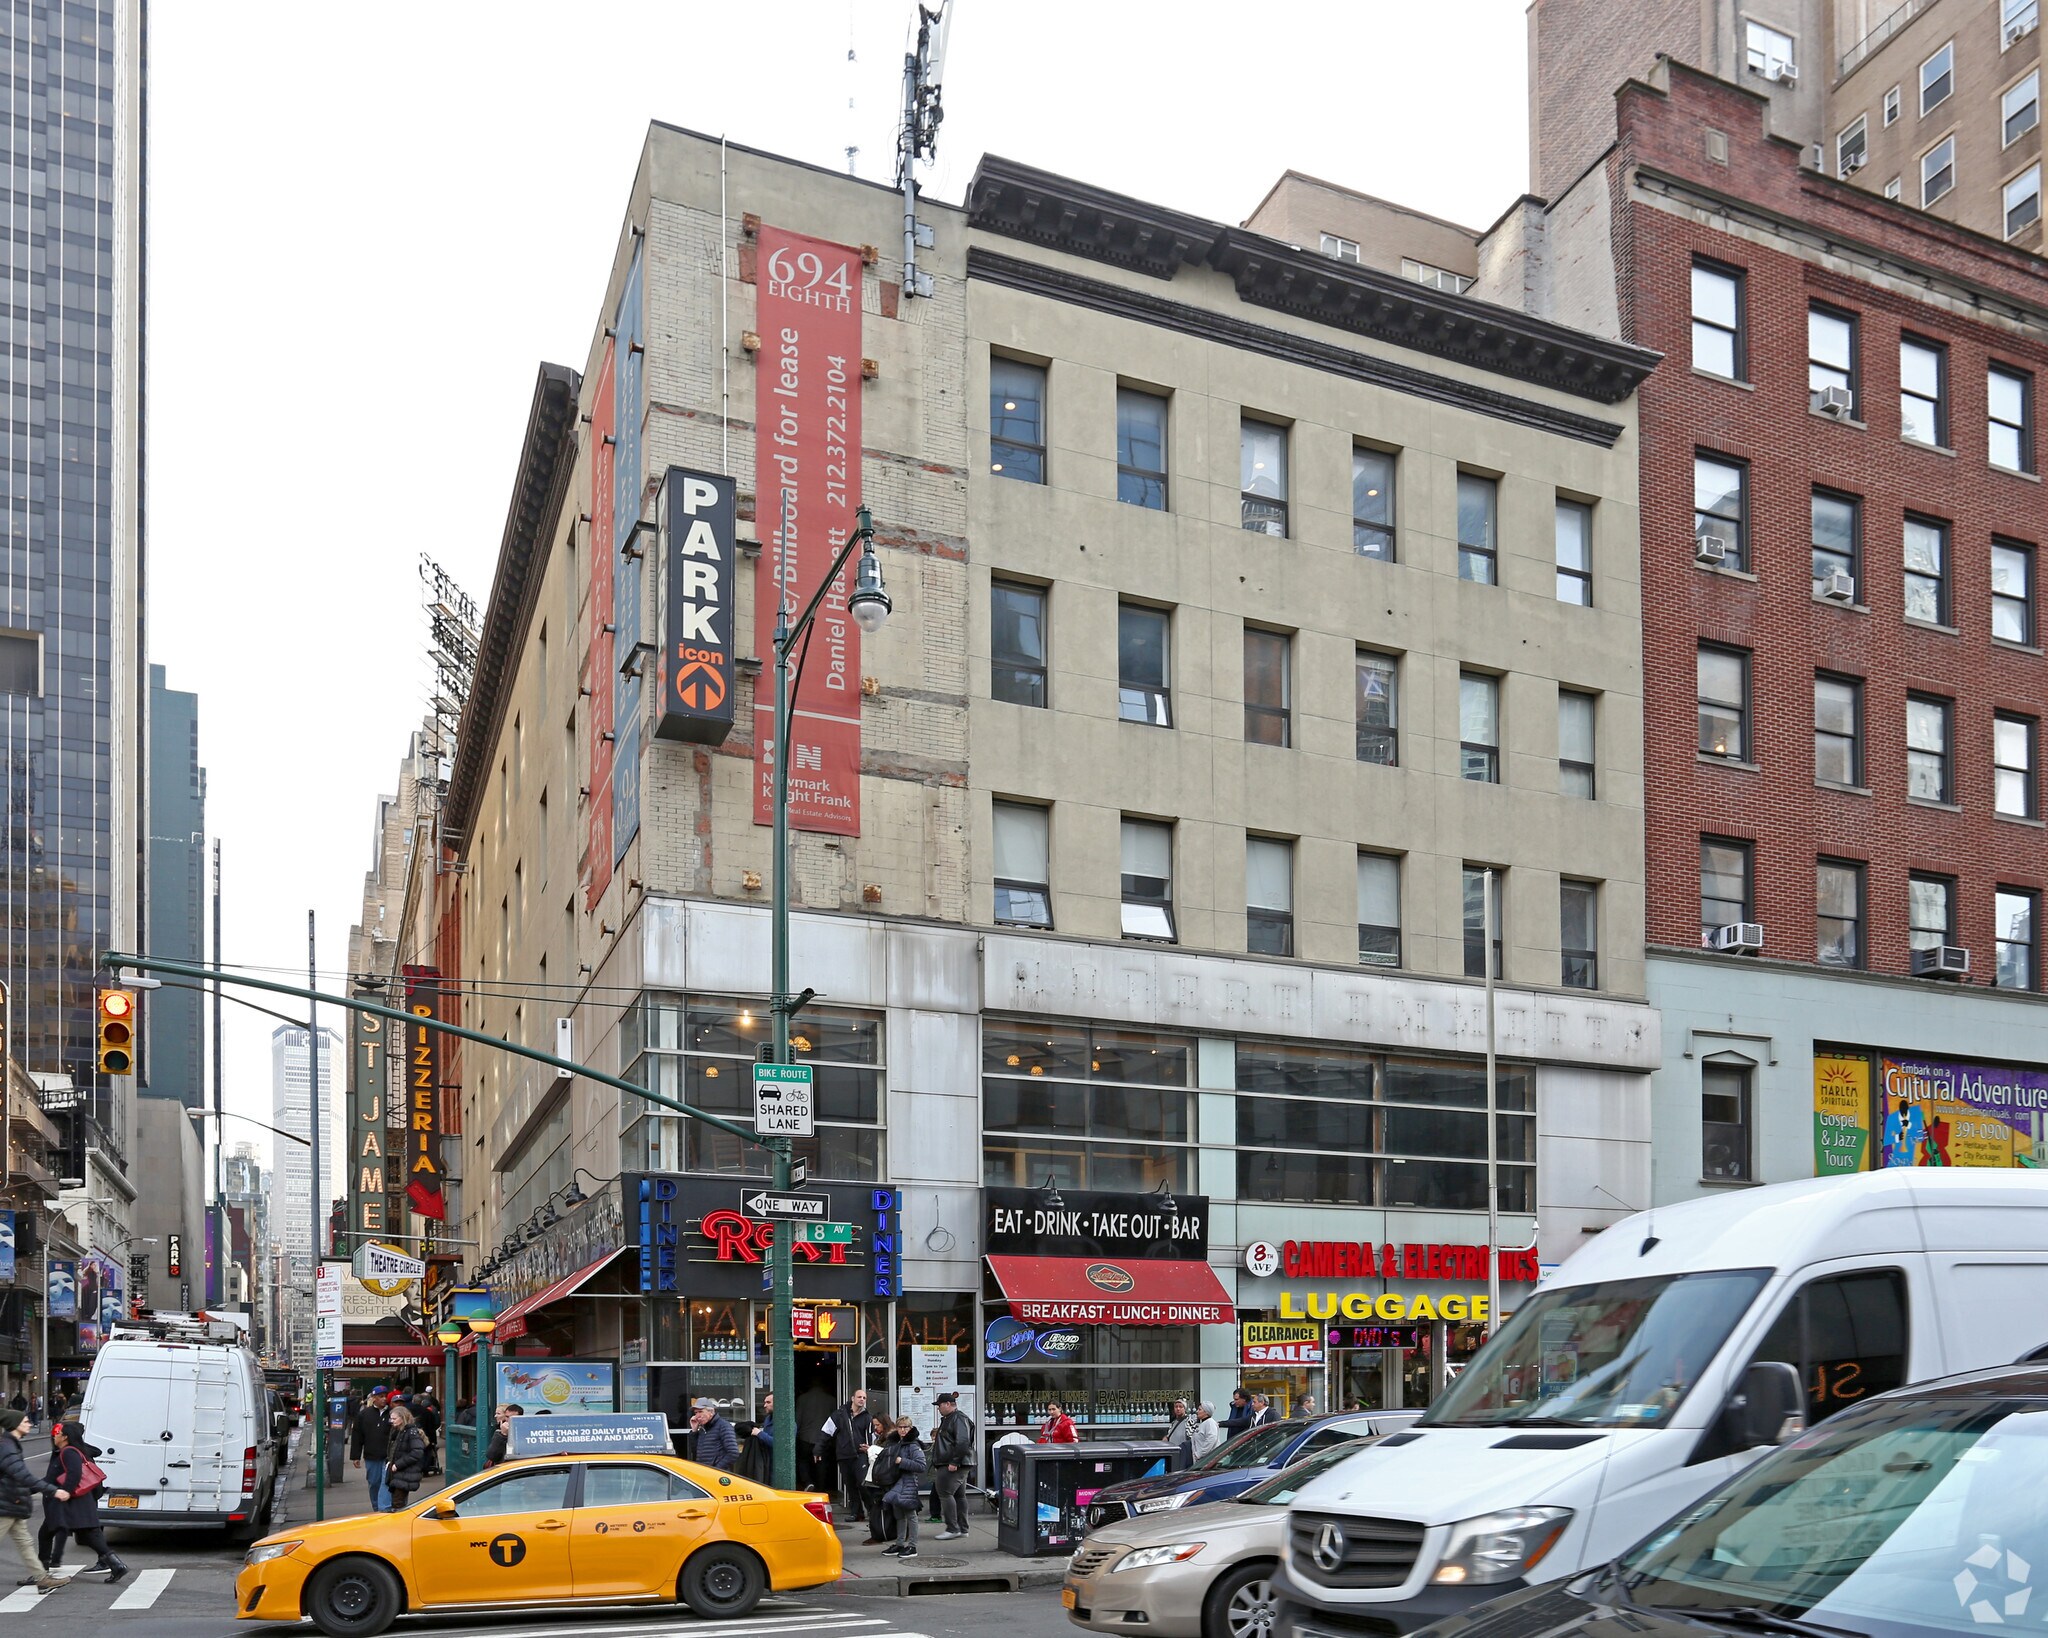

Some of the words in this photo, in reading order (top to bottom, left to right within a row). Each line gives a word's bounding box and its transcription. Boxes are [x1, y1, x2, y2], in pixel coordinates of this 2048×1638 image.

[768, 247, 852, 298] 694
[768, 280, 850, 314] EIGHTH
[773, 327, 799, 398] lease
[773, 404, 798, 446] for
[826, 355, 847, 508] 212.372.2104
[681, 477, 722, 645] PARK
[679, 643, 724, 666] icon
[826, 618, 846, 691] Daniel
[814, 792, 851, 808] Frank
[824, 812, 852, 822] Advisors
[758, 1068, 777, 1078] BIKE
[780, 1069, 808, 1079] ROUTE
[1901, 1062, 1932, 1077] Embark
[1933, 1067, 1944, 1077] on
[1945, 1069, 1951, 1077] a
[413, 1004, 437, 1174] PIZZERIA
[1821, 1085, 1859, 1098] HARLEM
[1885, 1068, 1955, 1104] Cultural
[760, 1104, 808, 1116] SHARED
[1820, 1096, 1859, 1108] SPIRITUALS
[768, 1118, 801, 1130] LANE
[1819, 1109, 1859, 1131] Gospel
[1821, 1130, 1831, 1146] &
[1833, 1132, 1857, 1148] Jazz
[1955, 1121, 2010, 1141] 391-0900
[1823, 1150, 1854, 1168] Tours
[360, 1096, 384, 1245] JAME
[755, 1198, 780, 1211] ONE
[791, 1201, 818, 1213] WAY
[814, 1224, 826, 1240] 8
[833, 1225, 845, 1234] AV
[994, 1209, 1023, 1234] EAT
[1034, 1210, 1082, 1237] DRINK
[1091, 1213, 1128, 1238] TAKE
[1130, 1214, 1162, 1239] OUT
[1171, 1215, 1200, 1240] BAR
[655, 1178, 679, 1291] DINER
[872, 1189, 893, 1296] DINER
[170, 1236, 179, 1266] PARK
[1281, 1239, 1377, 1279] CAMERA
[1381, 1243, 1400, 1278] &
[370, 1252, 398, 1273] THEATRE
[399, 1261, 422, 1274] CIRCLE
[1251, 1262, 1272, 1273] AVE
[318, 1268, 324, 1278] 3
[342, 1305, 398, 1315] AUGHTER
[1022, 1303, 1106, 1319] BREAKFAST
[1112, 1305, 1160, 1320] LUNCH
[1168, 1306, 1220, 1321] DINNER
[1279, 1292, 1489, 1321] LUGGAGE
[318, 1318, 324, 1328] 6
[1049, 1333, 1080, 1343] BUD
[1247, 1324, 1315, 1342] CLEARANCE
[1353, 1327, 1401, 1347] DVD's
[1042, 1341, 1080, 1350] LIGHT
[1248, 1344, 1314, 1362] SALE
[341, 1357, 377, 1365] OHN'S
[380, 1357, 430, 1365] PIZZERIA
[868, 1356, 886, 1364] 694
[987, 1390, 1033, 1403] BREAKFAST
[1060, 1390, 1090, 1403] DINNER
[1099, 1388, 1128, 1406] BAR
[335, 1403, 342, 1412] P
[530, 1430, 554, 1438] MORE
[556, 1429, 579, 1437] THAN
[539, 1436, 554, 1444] THE
[556, 1435, 602, 1443] CARIBBEAN
[623, 1433, 654, 1441] MEXICO
[722, 1493, 753, 1503] 3838
[496, 1539, 518, 1563] T
